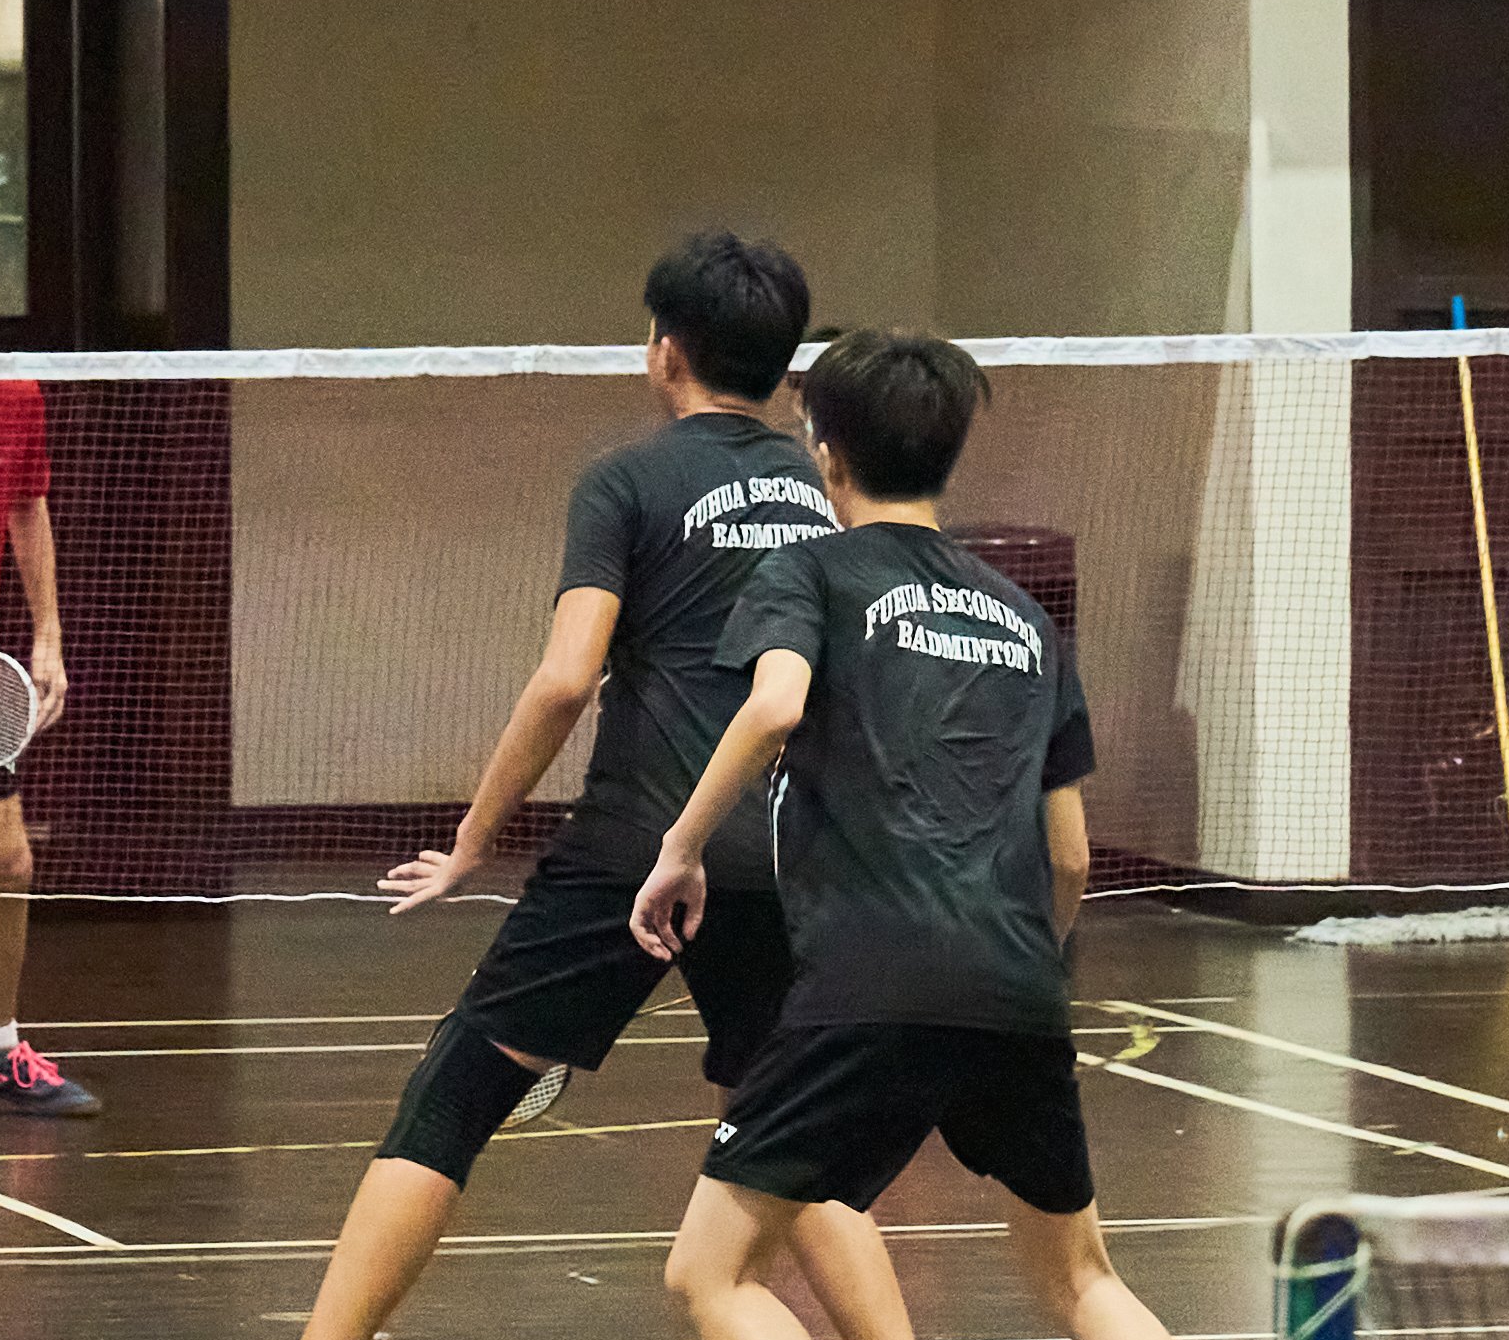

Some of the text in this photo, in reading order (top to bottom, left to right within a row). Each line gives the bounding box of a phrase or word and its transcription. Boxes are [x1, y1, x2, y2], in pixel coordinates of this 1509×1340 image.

[682, 476, 846, 541] FUHUA SECONDA
[711, 522, 838, 549] BADMINTO
[864, 582, 1043, 676] FUHUA SECONDARY
[896, 619, 1030, 673] BADMINTON
